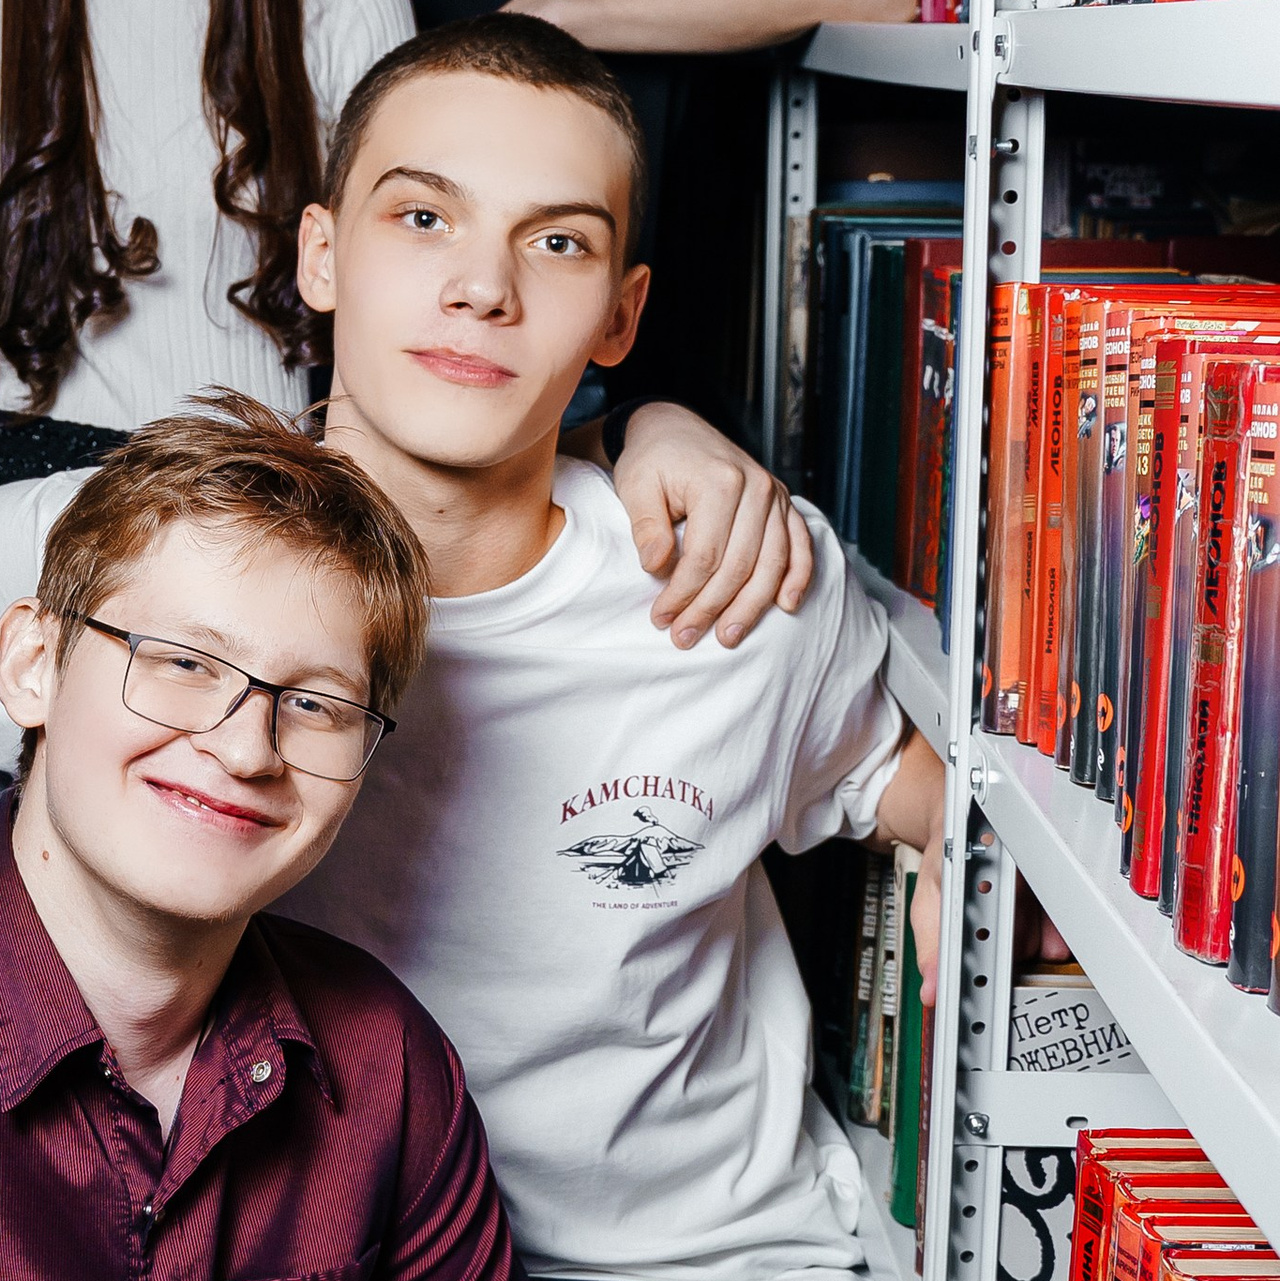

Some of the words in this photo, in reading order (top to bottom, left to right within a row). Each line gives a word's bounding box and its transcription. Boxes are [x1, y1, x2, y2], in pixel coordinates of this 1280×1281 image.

[1050, 374, 1063, 477] ЛЕОНОВ
[1023, 530, 1034, 600] Алексей
[1030, 361, 1040, 428] МАКЕЕВ
[1149, 431, 1165, 577] ЛЕОНОВ
[1204, 459, 1228, 616] ЛЕОНОВ
[1045, 567, 1057, 655] Николай
[559, 774, 715, 825] KAMCHATKA
[591, 900, 607, 910] THE
[608, 901, 630, 911] LAND
[630, 901, 640, 911] OF
[641, 899, 680, 911] ADVENTURE
[1013, 1003, 1091, 1043] Петр
